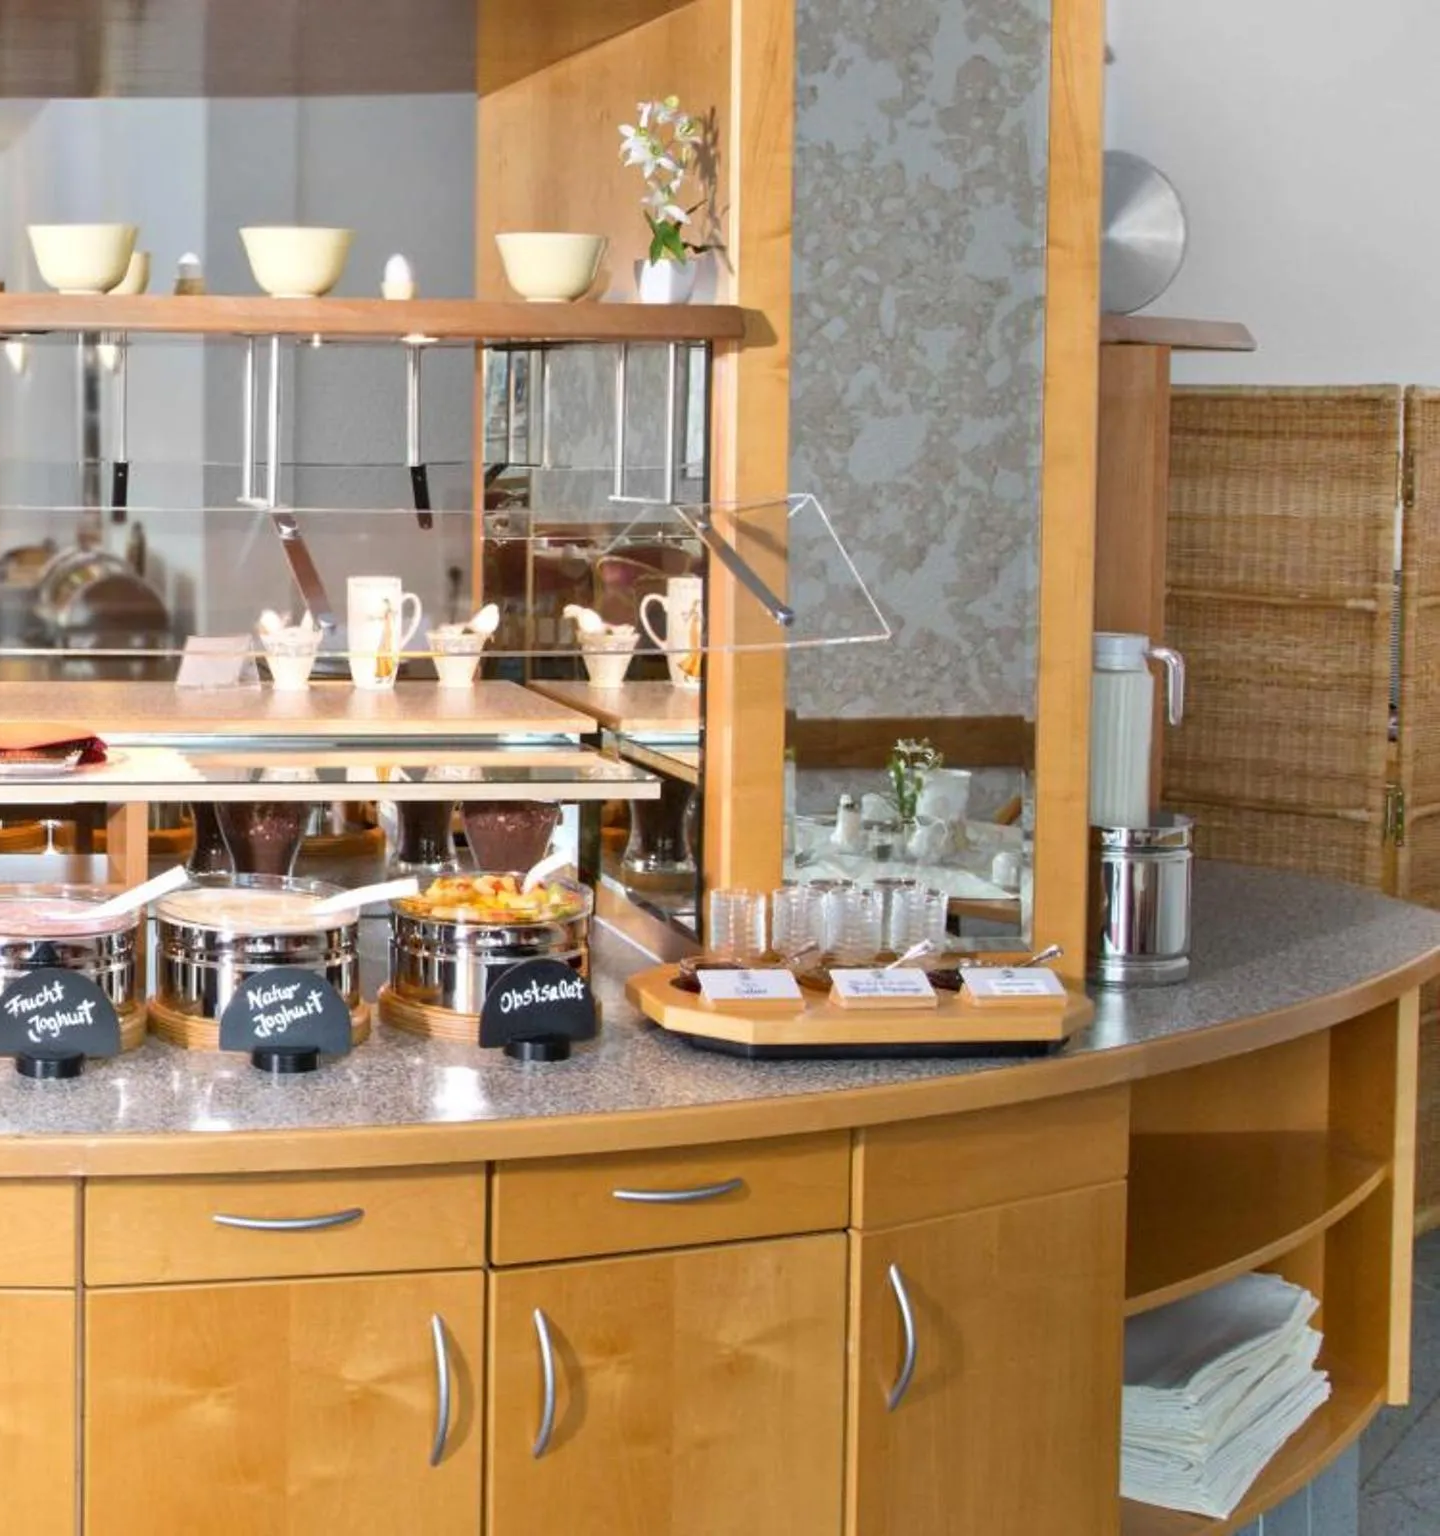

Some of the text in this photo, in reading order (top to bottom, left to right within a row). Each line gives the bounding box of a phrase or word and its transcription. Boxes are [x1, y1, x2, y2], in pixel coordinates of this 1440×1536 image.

[4, 980, 64, 1018] Frucht
[246, 982, 300, 1010] Natur
[252, 989, 323, 1038] Joghurt
[500, 977, 585, 1014] Obstsalat
[27, 999, 96, 1043] Joghurt
